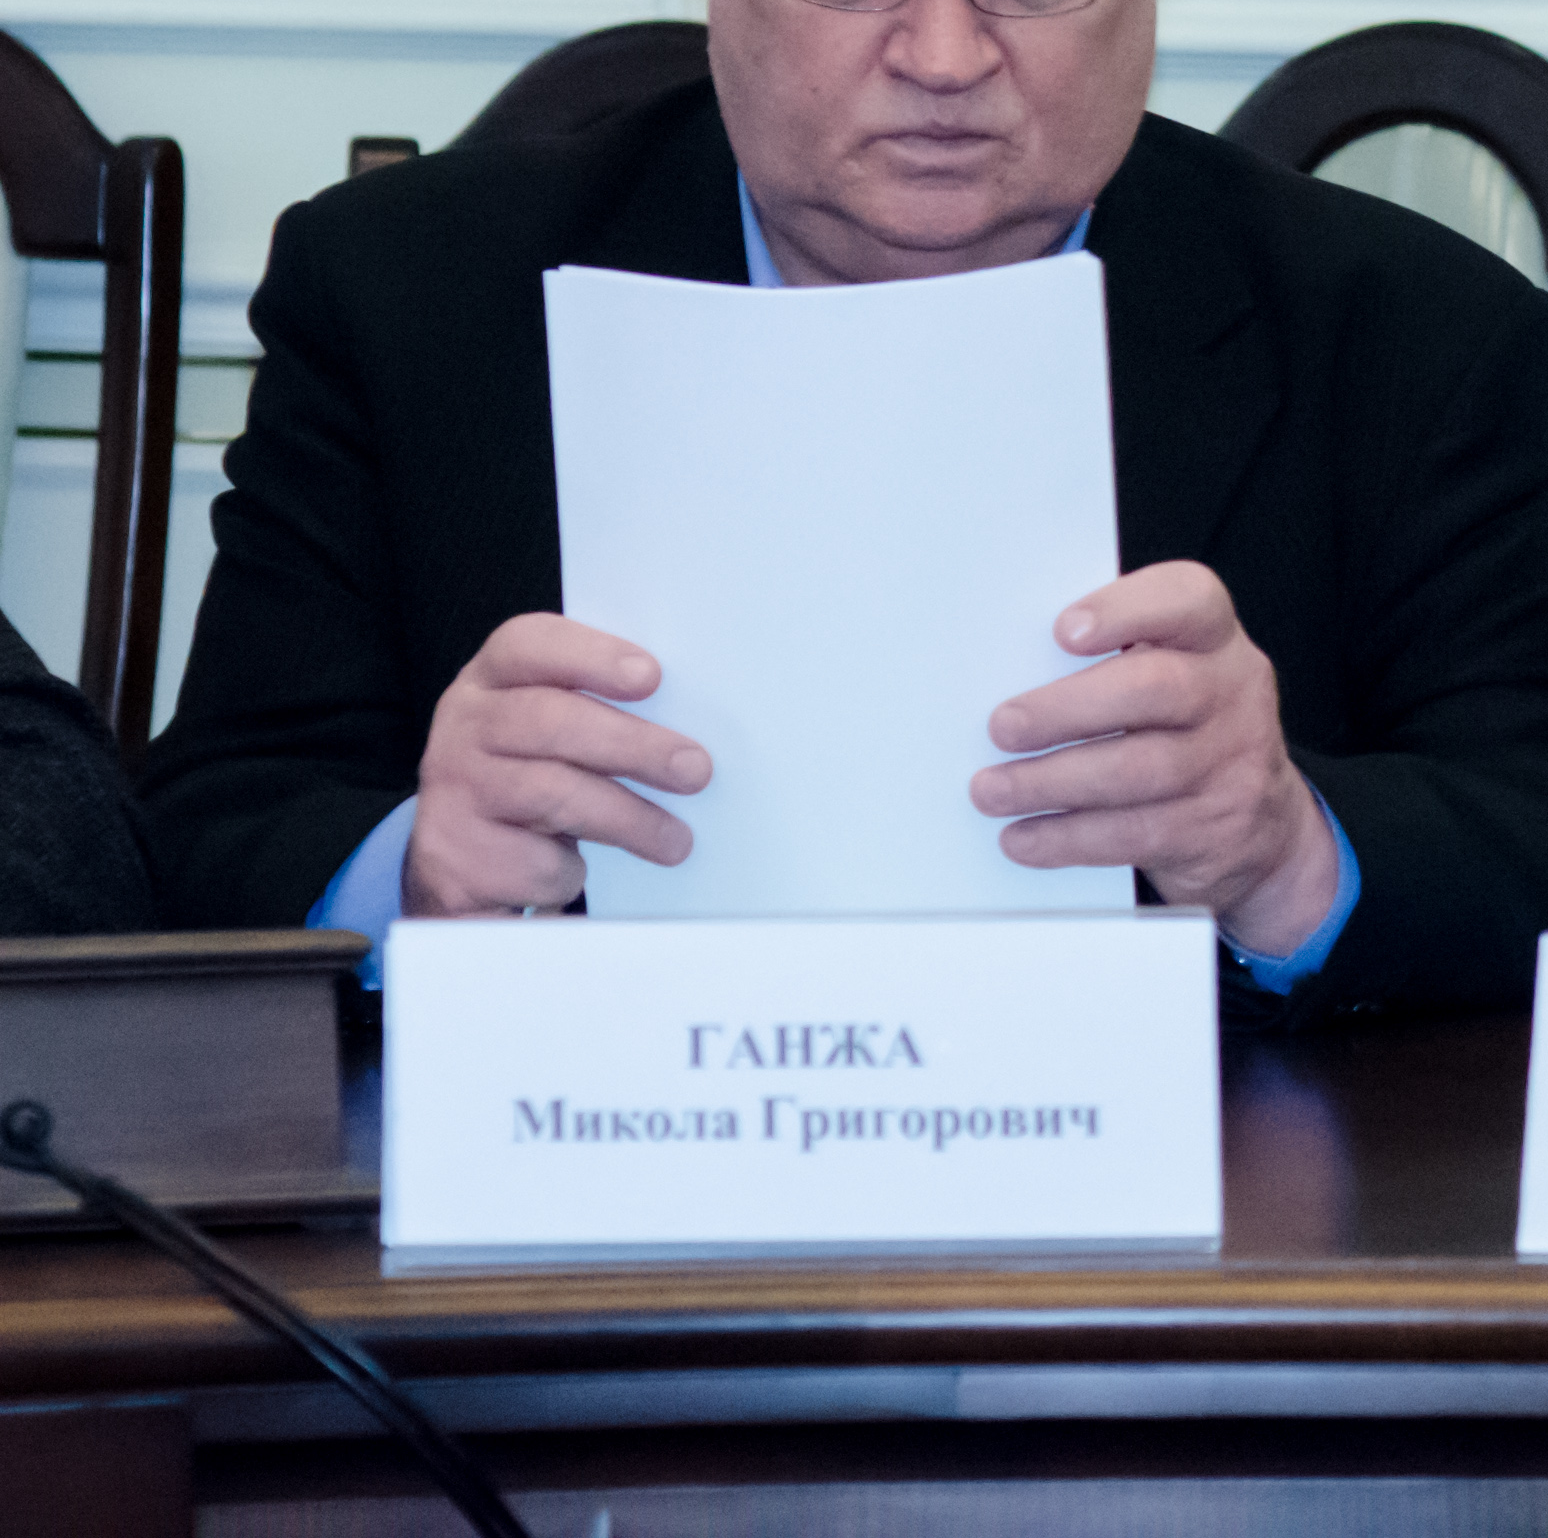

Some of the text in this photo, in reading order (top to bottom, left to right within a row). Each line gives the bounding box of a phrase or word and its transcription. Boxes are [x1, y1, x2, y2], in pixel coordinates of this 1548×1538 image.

[687, 1022, 925, 1069] ГАНЖА
[512, 1095, 1101, 1154] Микола Григорович
